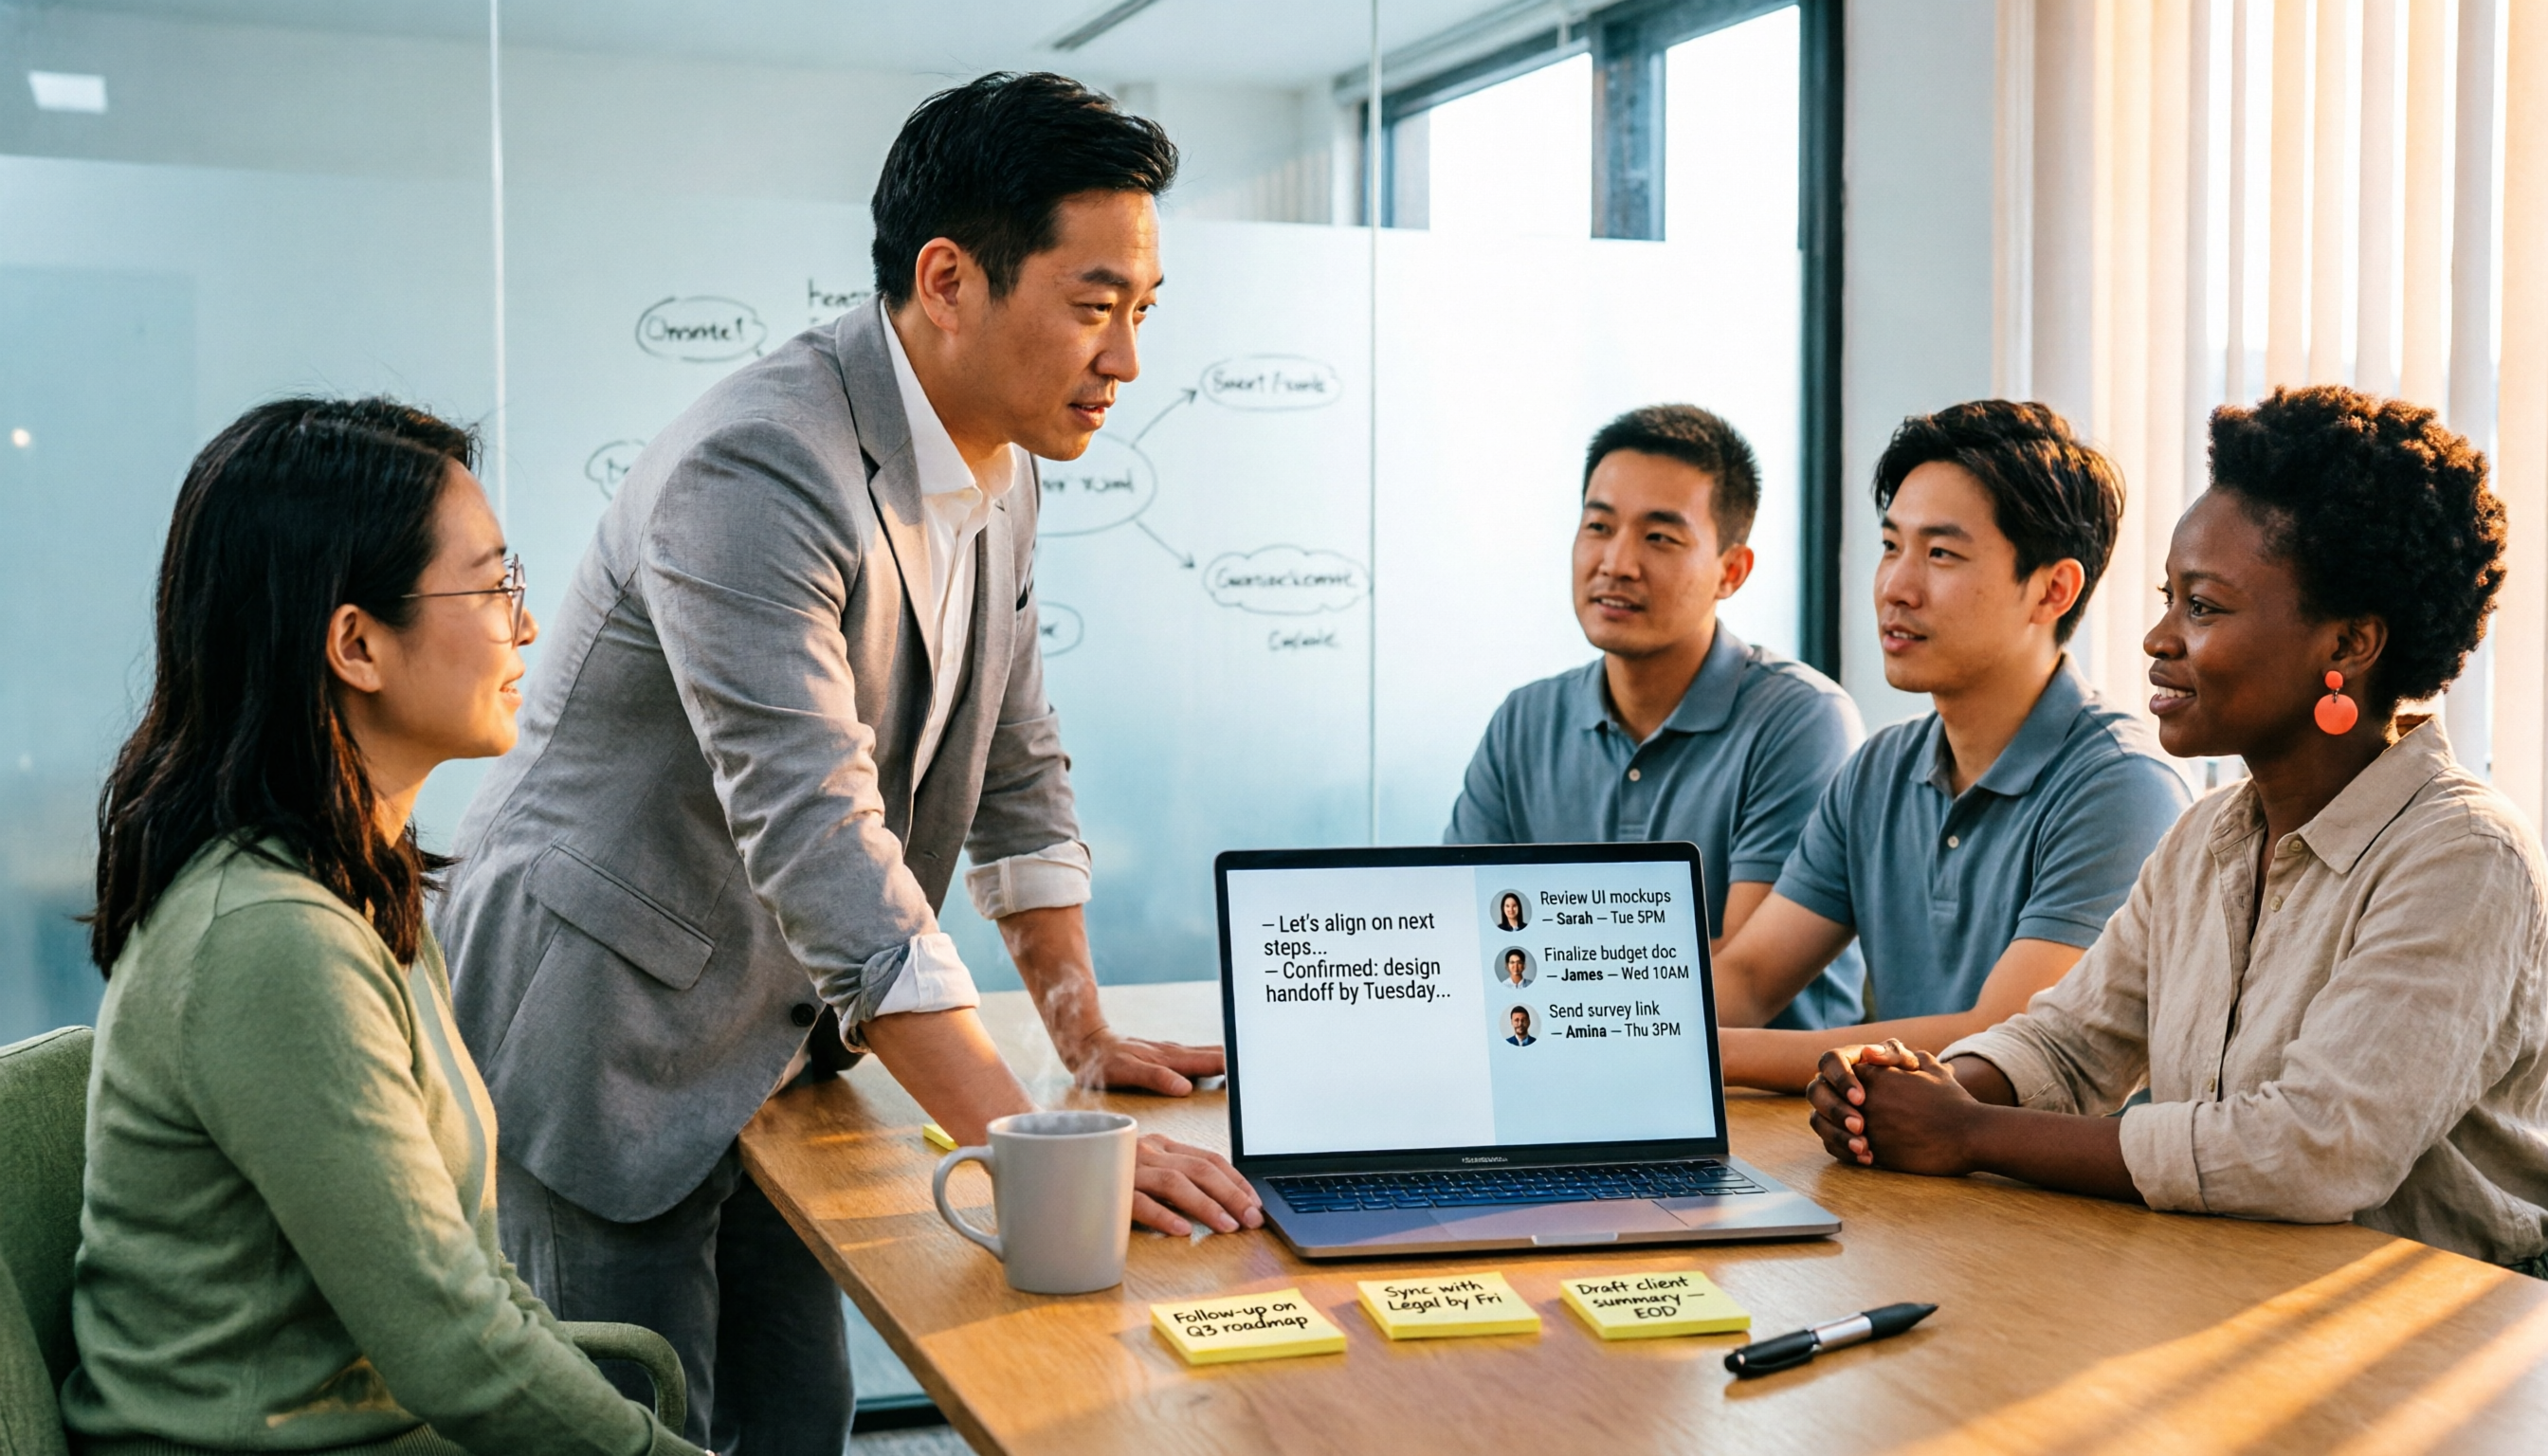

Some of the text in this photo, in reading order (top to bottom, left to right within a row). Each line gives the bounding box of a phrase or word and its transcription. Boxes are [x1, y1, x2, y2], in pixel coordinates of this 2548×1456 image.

[1540, 888, 1671, 906] Review UI mockups
[1280, 913, 1320, 933] Let's
[1325, 913, 1366, 936] align
[1372, 917, 1392, 930] on
[1399, 913, 1435, 929] next
[1556, 911, 1593, 925] Sarah
[1611, 911, 1634, 924] Tue
[1638, 910, 1665, 923] 5PM
[1265, 939, 1327, 959] steps...
[1544, 944, 1677, 963] Finalize budget doc
[1283, 958, 1378, 979] Confirmed:
[1384, 957, 1441, 979] design
[1561, 969, 1603, 981] James
[1621, 966, 1648, 979] Wed
[1653, 965, 1689, 979] 10AM
[1266, 980, 1450, 1005] handoff by Tuesday...
[1549, 1000, 1660, 1020] Send survey link
[1566, 1025, 1607, 1038] Amina
[1625, 1023, 1648, 1037] Thu
[1652, 1022, 1681, 1036] 3PM
[1384, 1281, 1484, 1301] Sync with
[1575, 1276, 1689, 1295] Draft client
[1388, 1293, 1502, 1314] Legal by Fri
[1592, 1294, 1681, 1307] summary
[1174, 1302, 1297, 1323] Follow-up on
[1633, 1305, 1677, 1320] EOD
[1186, 1316, 1308, 1338] Q3 roadmap
